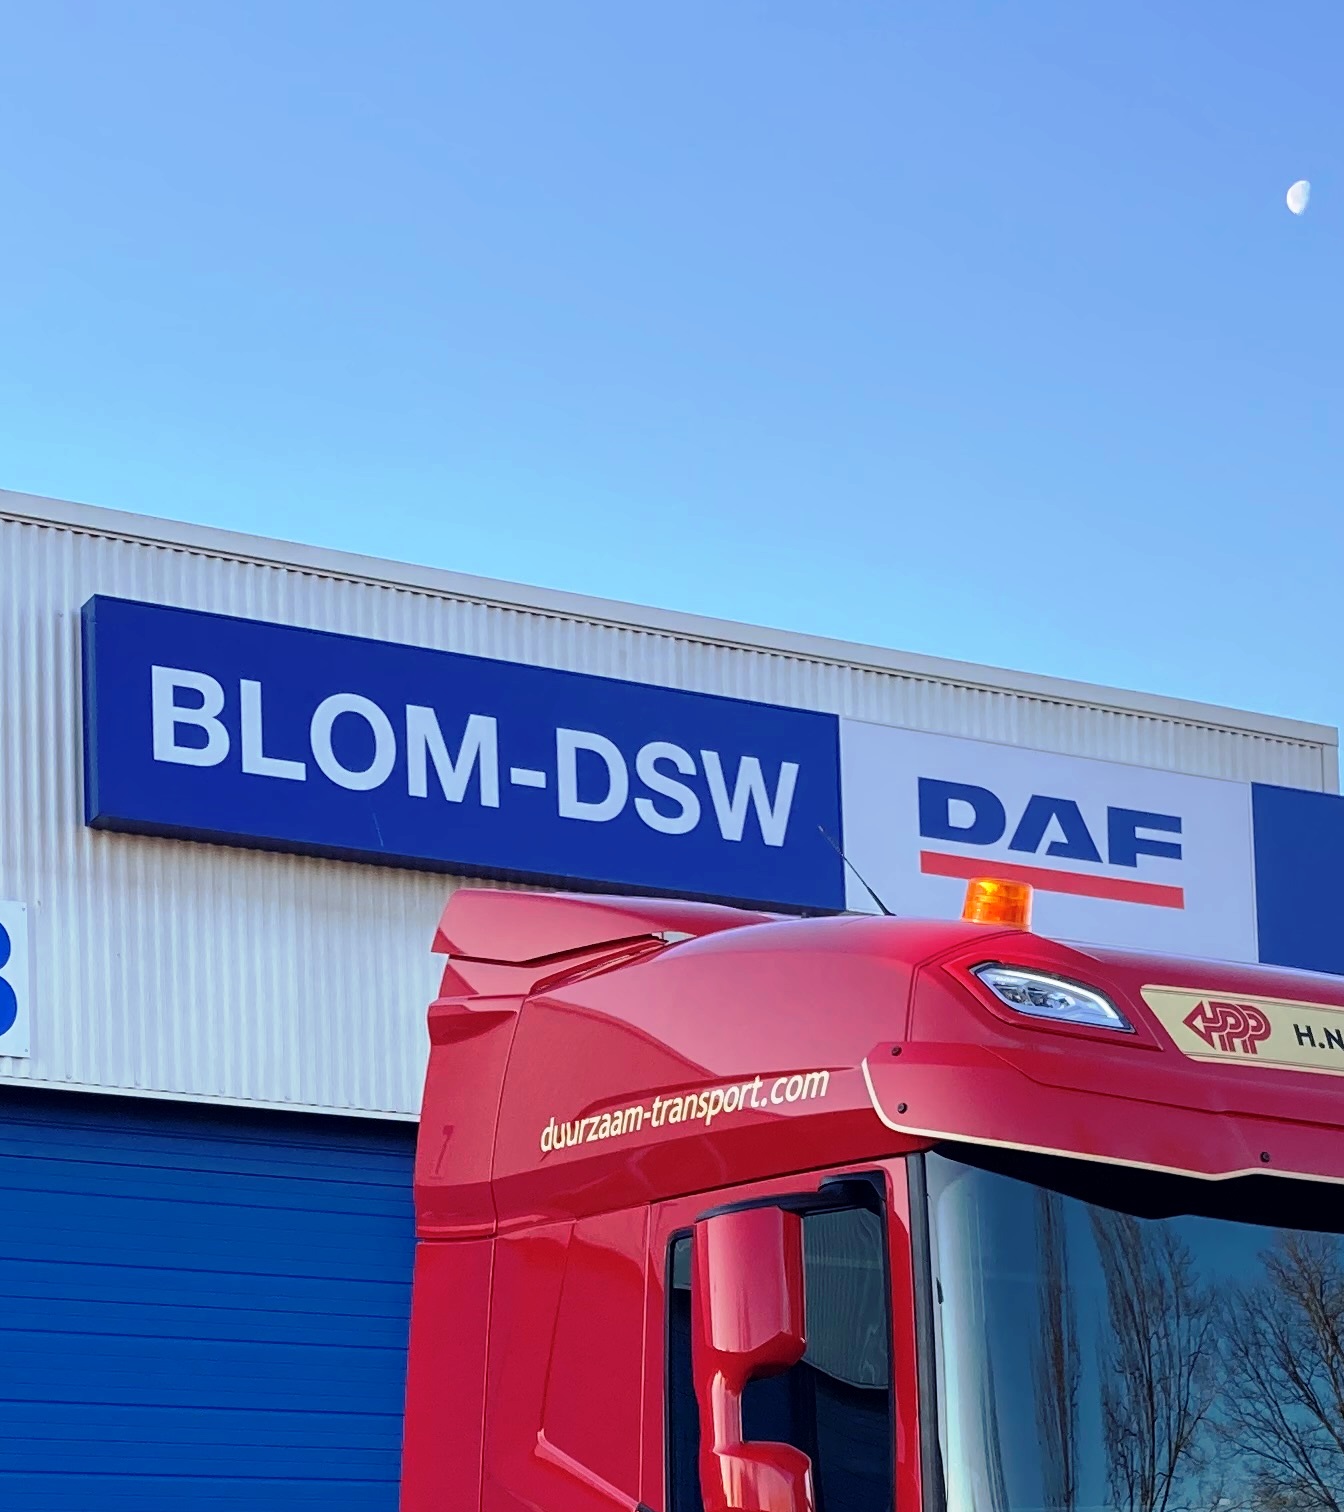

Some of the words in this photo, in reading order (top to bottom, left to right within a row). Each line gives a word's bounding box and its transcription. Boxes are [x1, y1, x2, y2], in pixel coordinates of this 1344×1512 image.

[151, 664, 799, 847] BLOM-DSW
[917, 776, 1182, 868] DAF
[540, 1069, 830, 1152] duurzaam-transport.com
